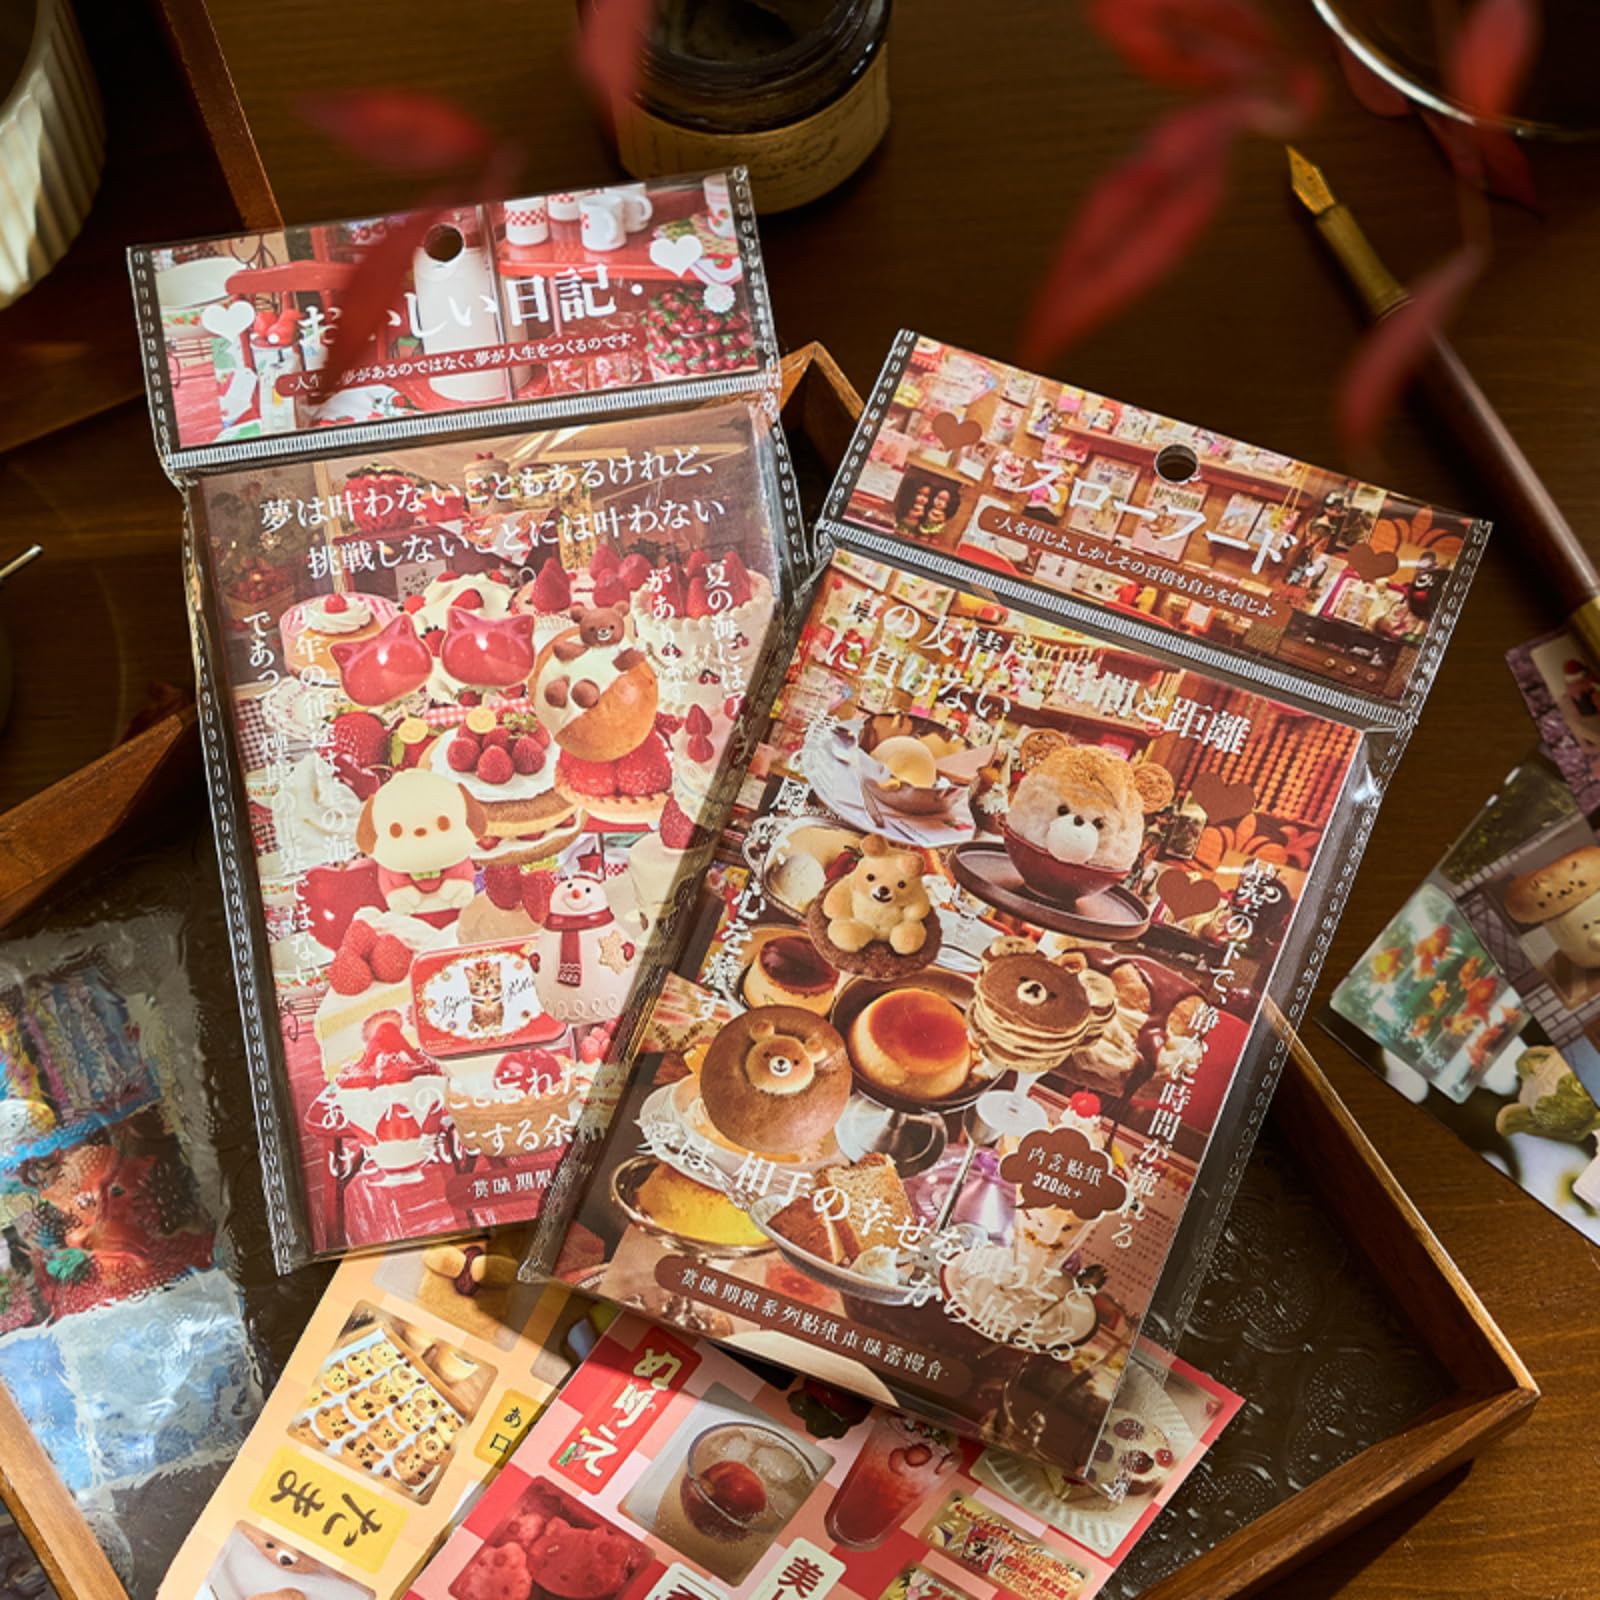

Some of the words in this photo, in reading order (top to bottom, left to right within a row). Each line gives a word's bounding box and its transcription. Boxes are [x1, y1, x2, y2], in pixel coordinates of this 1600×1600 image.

[1015, 459, 1298, 575] スローフード
[270, 1469, 382, 1548] たま
